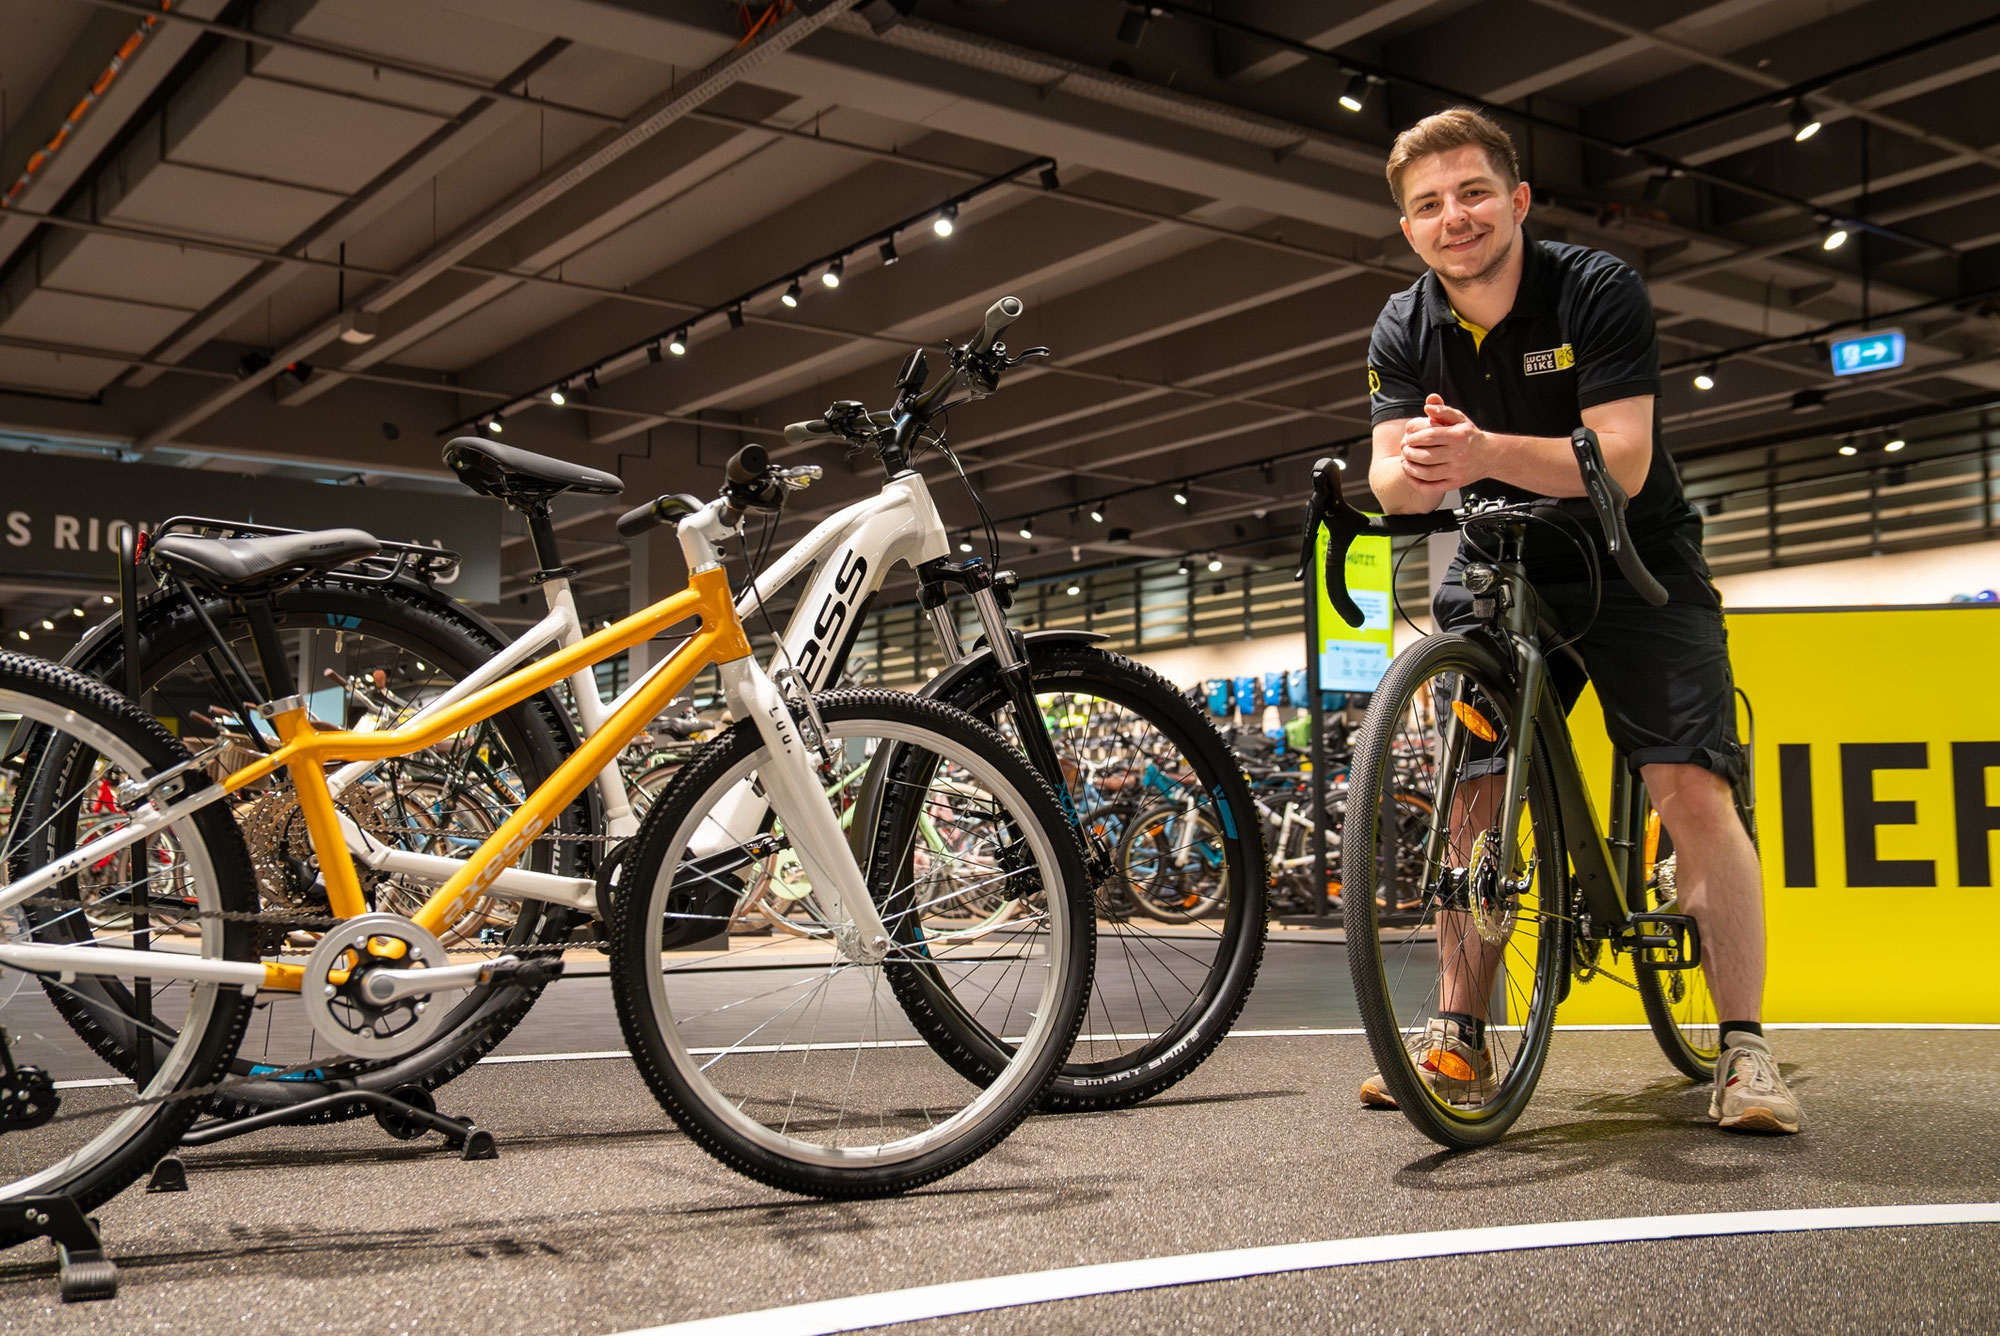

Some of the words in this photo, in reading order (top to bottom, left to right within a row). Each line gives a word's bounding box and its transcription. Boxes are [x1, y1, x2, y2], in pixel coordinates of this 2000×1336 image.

[1526, 353, 1553, 364] LUCKY
[1526, 360, 1555, 372] BIKE
[1591, 480, 1608, 511] GRX
[788, 549, 868, 692] ess
[52, 741, 81, 811] MART
[1073, 1067, 1142, 1087] SMART
[1147, 1042, 1188, 1069] SAM
